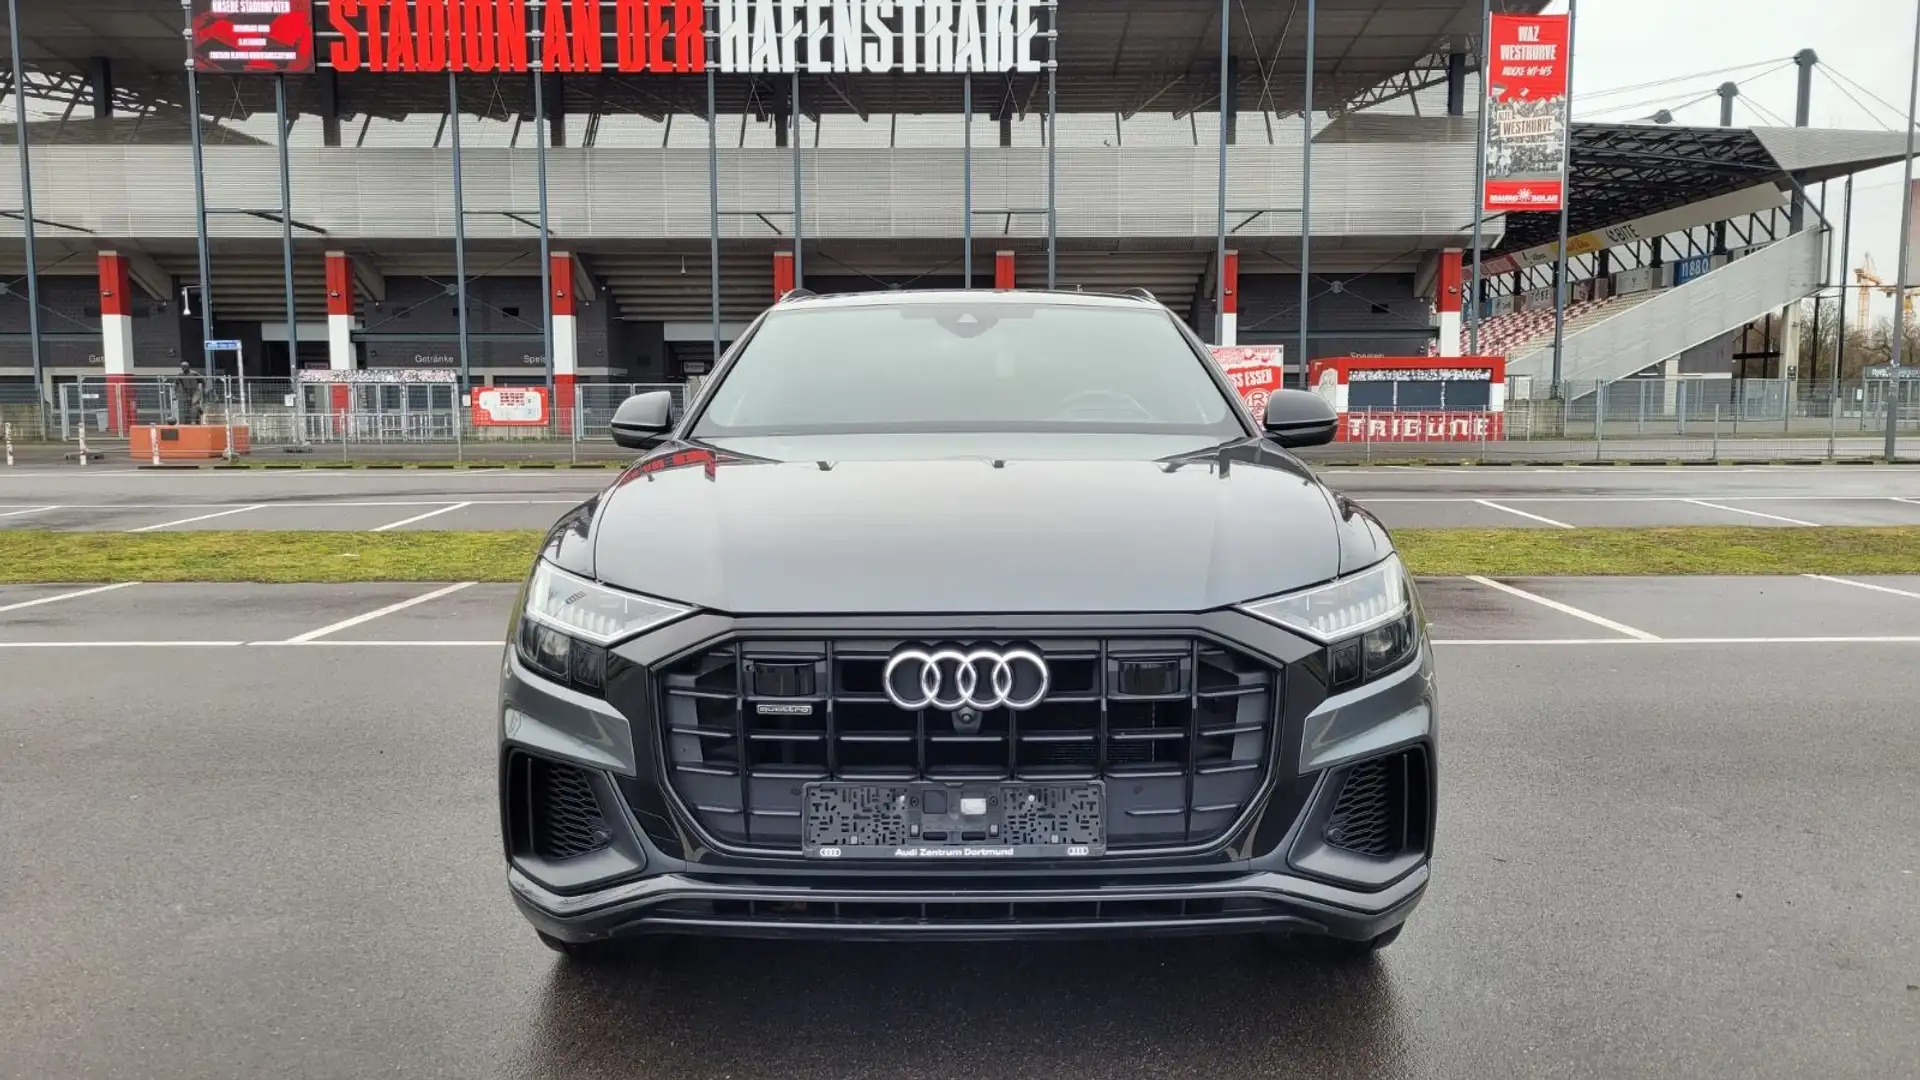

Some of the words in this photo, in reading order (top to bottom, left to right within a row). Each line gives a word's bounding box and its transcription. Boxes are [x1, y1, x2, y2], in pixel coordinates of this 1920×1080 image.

[329, 0, 528, 72] STADION
[543, 0, 601, 72] AN
[617, 0, 705, 72] DER
[1518, 25, 1540, 42] WAZ
[1500, 44, 1557, 61] WESTKURVE
[1503, 118, 1553, 135] WESTKURVE
[1244, 368, 1273, 387] ESSEN
[895, 848, 918, 857] Audi
[920, 848, 962, 857] Zentrum
[963, 848, 1014, 857] Dortmund
